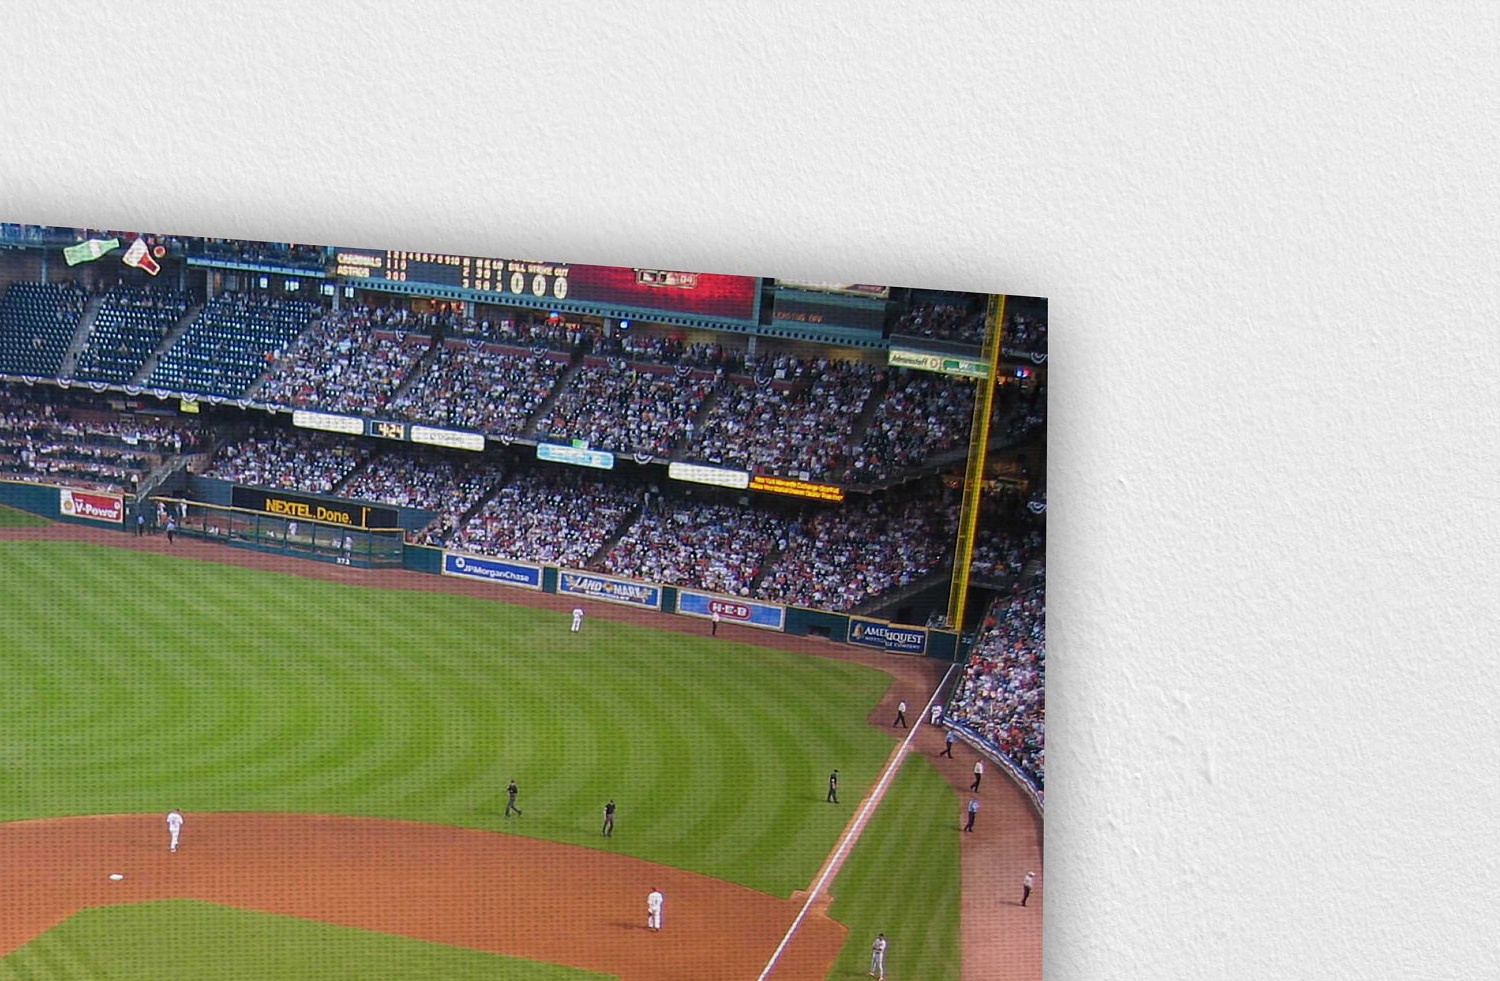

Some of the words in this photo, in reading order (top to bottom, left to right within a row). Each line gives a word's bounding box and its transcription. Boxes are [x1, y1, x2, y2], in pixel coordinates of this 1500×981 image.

[554, 267, 569, 277] OUT
[510, 272, 524, 294] 0
[532, 274, 546, 297] 0
[554, 277, 567, 299] 0
[75, 501, 119, 519] V-Power
[463, 565, 530, 582] JPMorganChase
[575, 577, 602, 592] LAND
